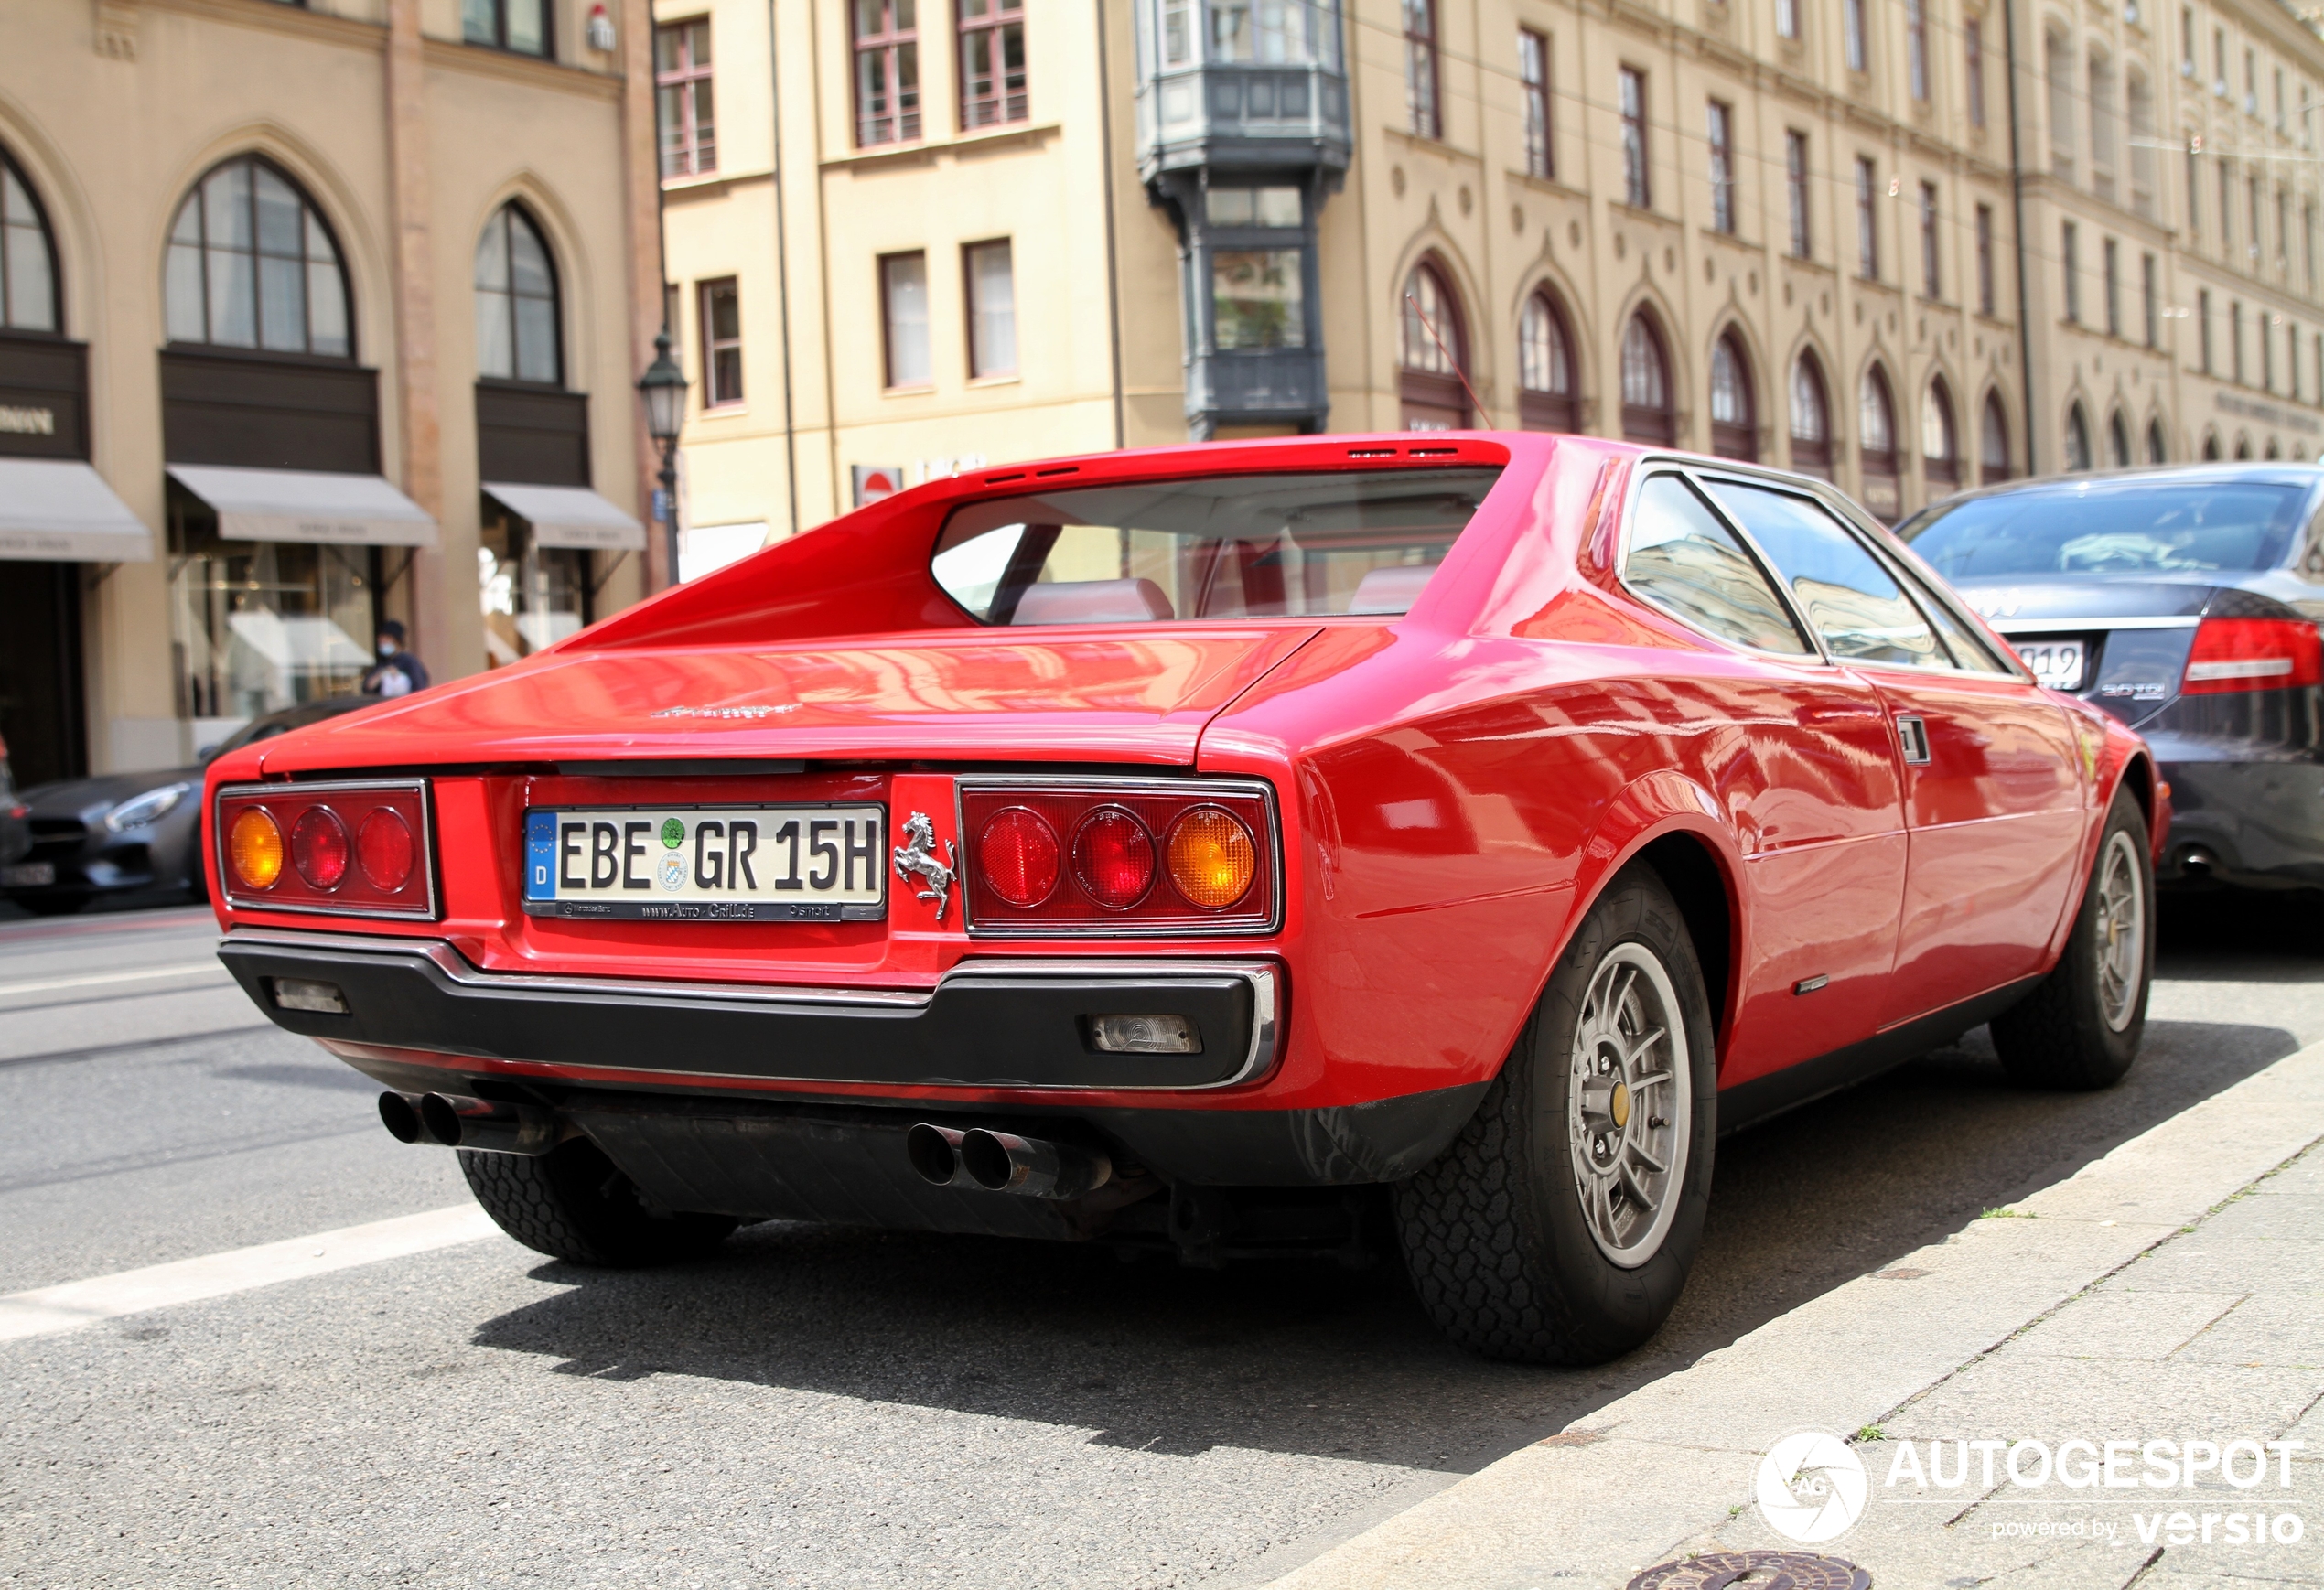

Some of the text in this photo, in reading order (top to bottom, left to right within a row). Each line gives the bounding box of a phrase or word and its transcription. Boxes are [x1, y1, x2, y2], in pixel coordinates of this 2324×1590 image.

[537, 865, 547, 886] D
[561, 820, 876, 890] EBE GR 15H
